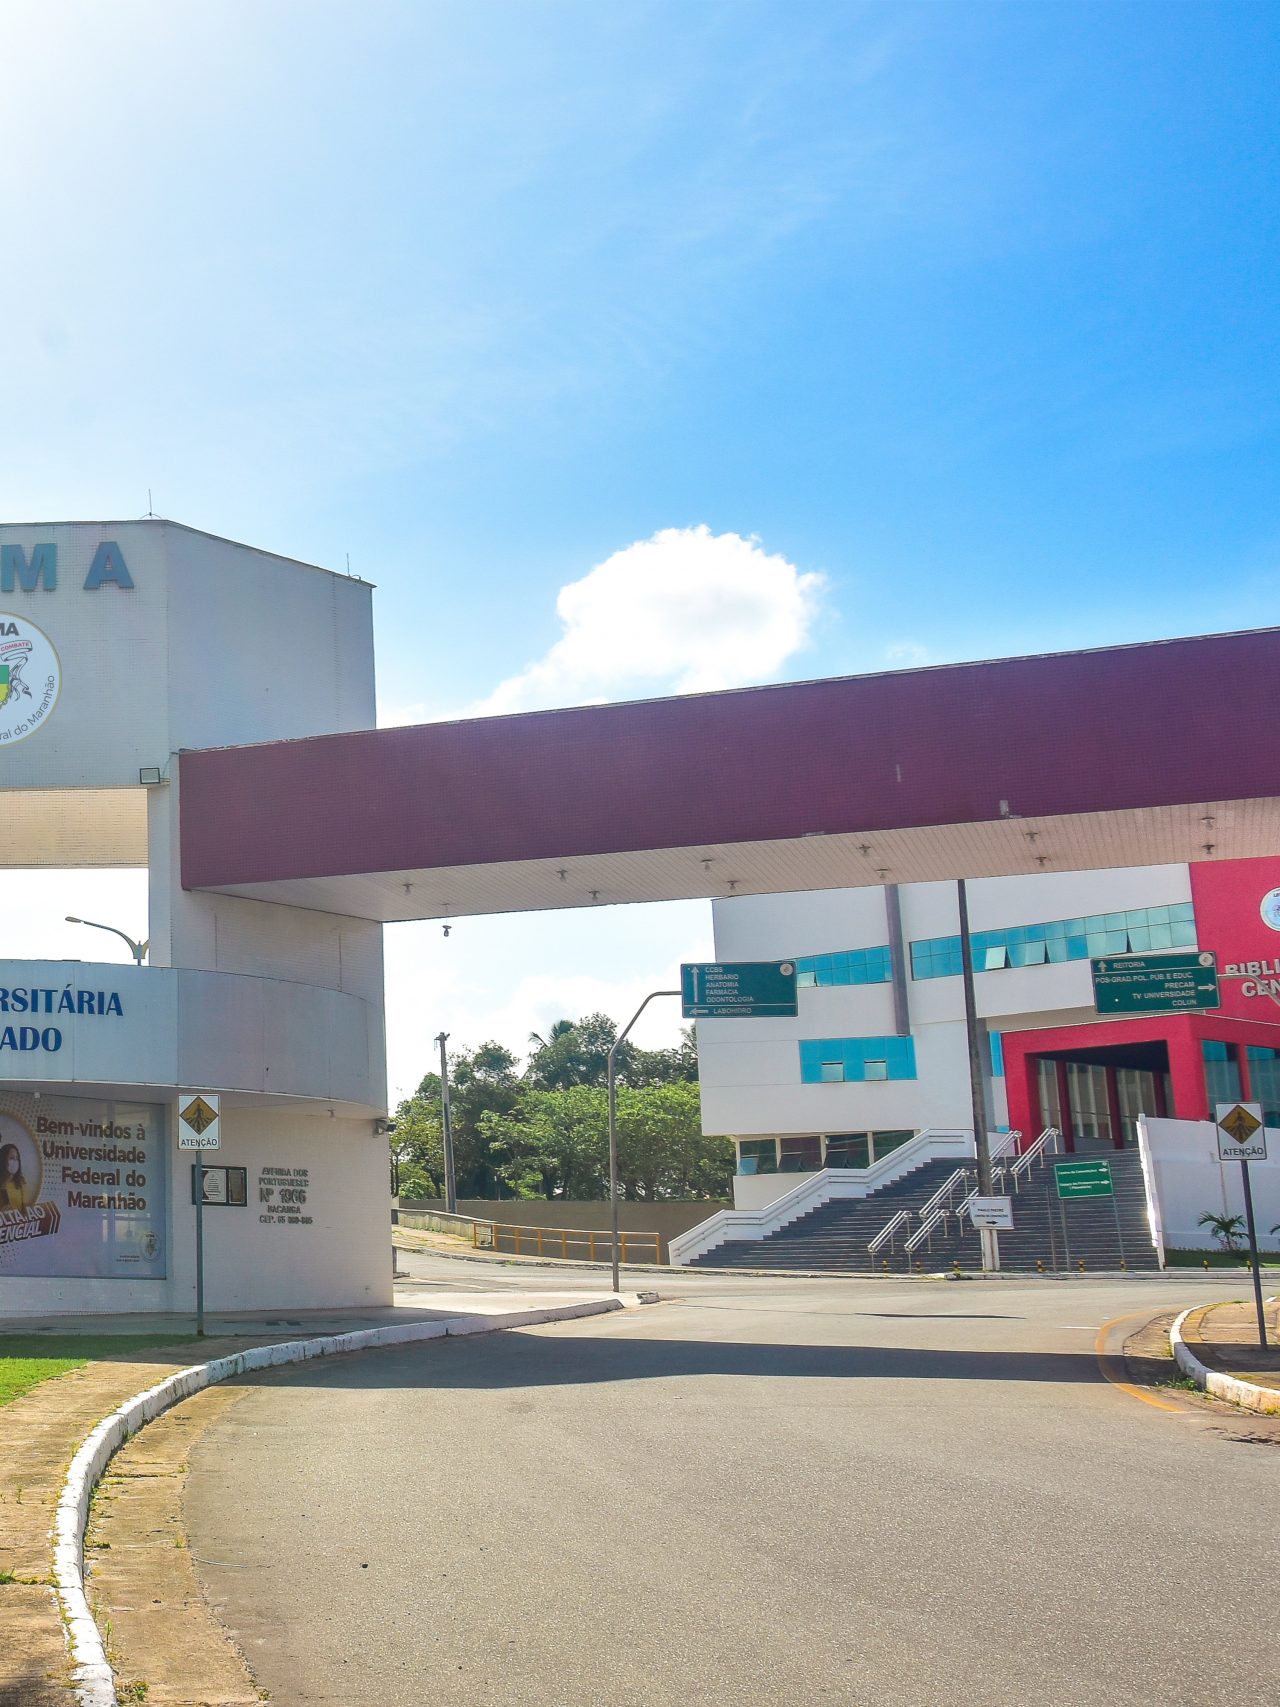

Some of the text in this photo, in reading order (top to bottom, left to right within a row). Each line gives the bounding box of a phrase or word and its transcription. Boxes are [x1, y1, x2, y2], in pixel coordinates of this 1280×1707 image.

[1, 641, 30, 651] COMBATE
[14, 724, 29, 735] do
[26, 675, 55, 726] Maranhão
[1113, 961, 1146, 969] REITORIA
[1144, 990, 1196, 998] UNIVERSIDADE
[37, 1116, 146, 1140] Bem-vindos à
[181, 1138, 218, 1148] ATENÇÃO
[42, 1140, 146, 1163] Universidade
[1222, 1145, 1264, 1157] ATENÇÃO
[62, 1165, 146, 1187] Federal do
[293, 1168, 309, 1177] DOS
[67, 1190, 147, 1211] Maranhão
[26, 1205, 46, 1221] AO
